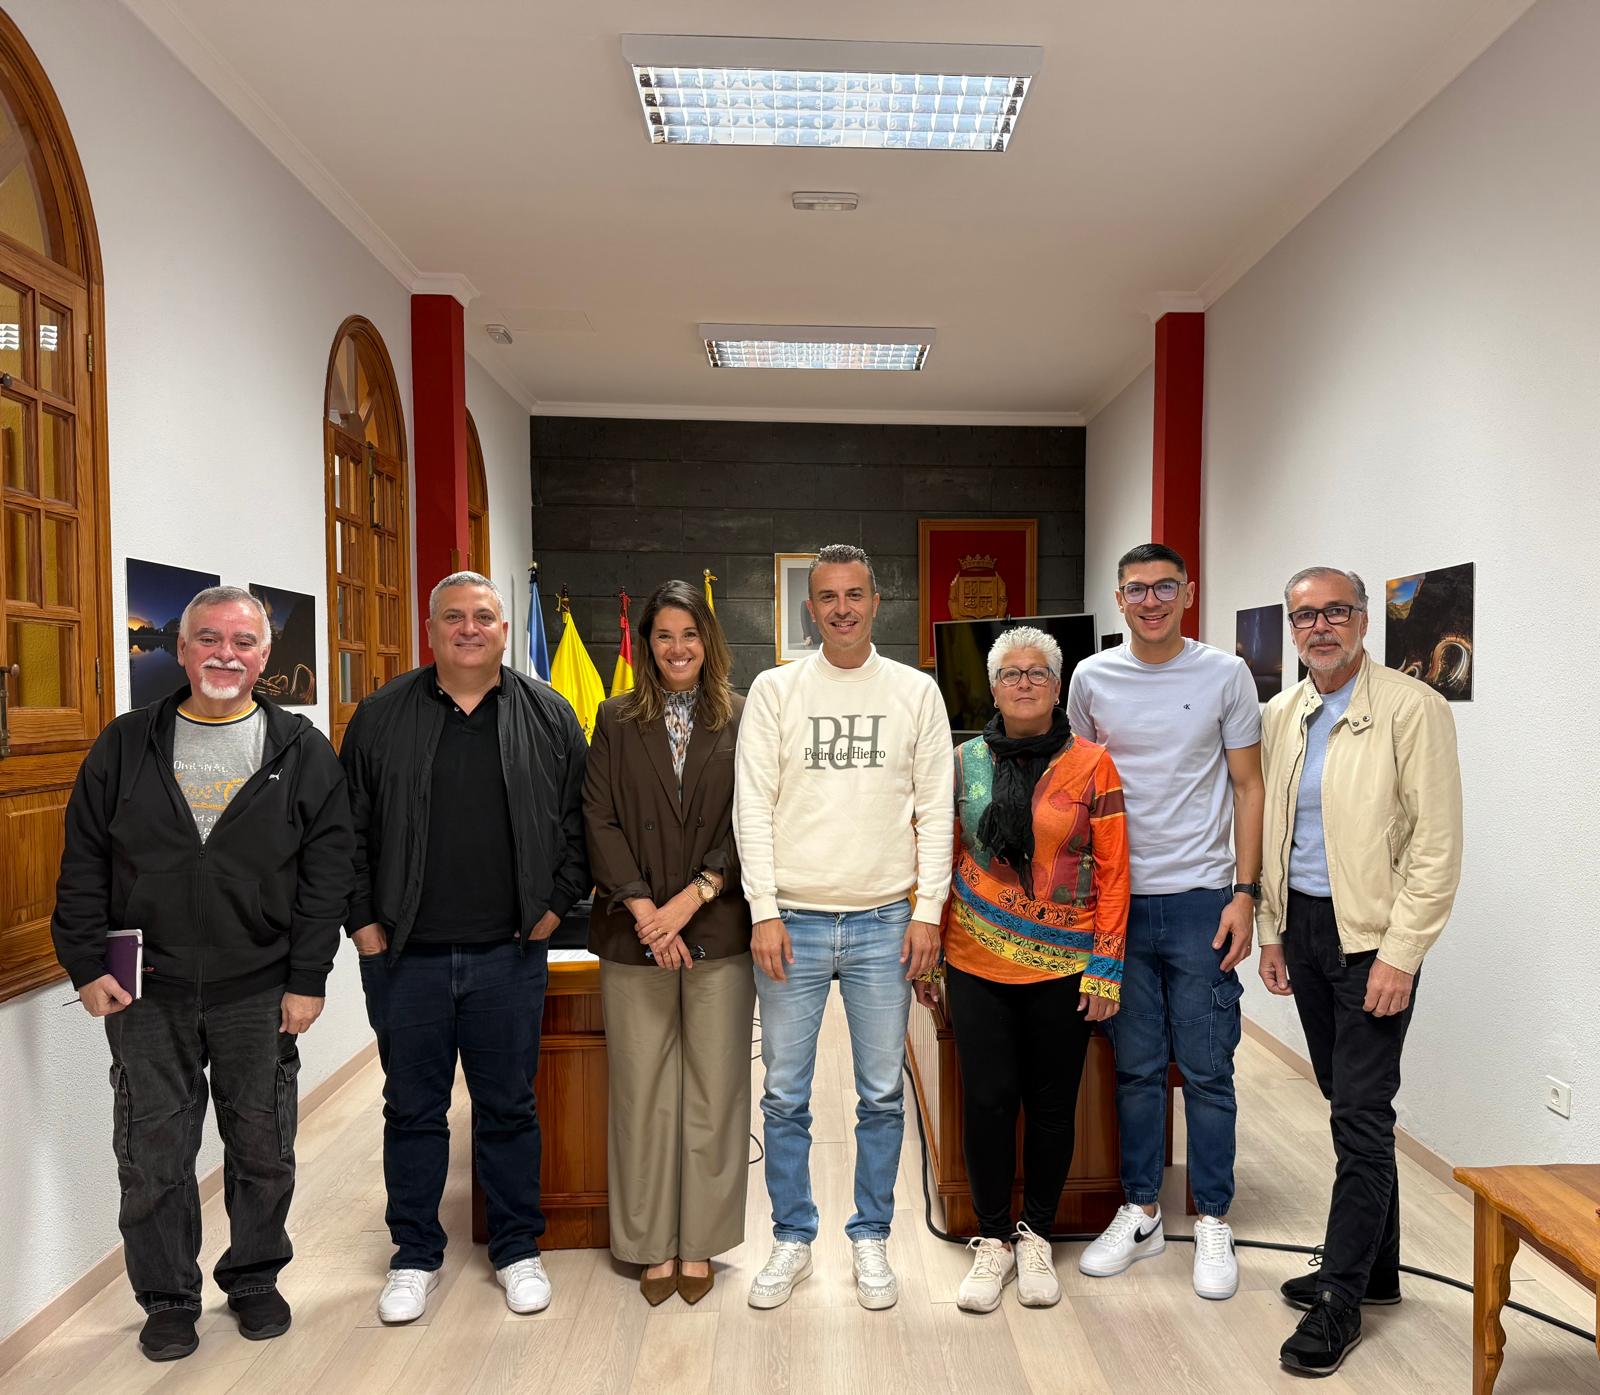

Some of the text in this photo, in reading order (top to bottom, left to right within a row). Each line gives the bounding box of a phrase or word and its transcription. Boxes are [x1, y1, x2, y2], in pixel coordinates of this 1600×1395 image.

[804, 746, 886, 761] Pedro del Hierro
